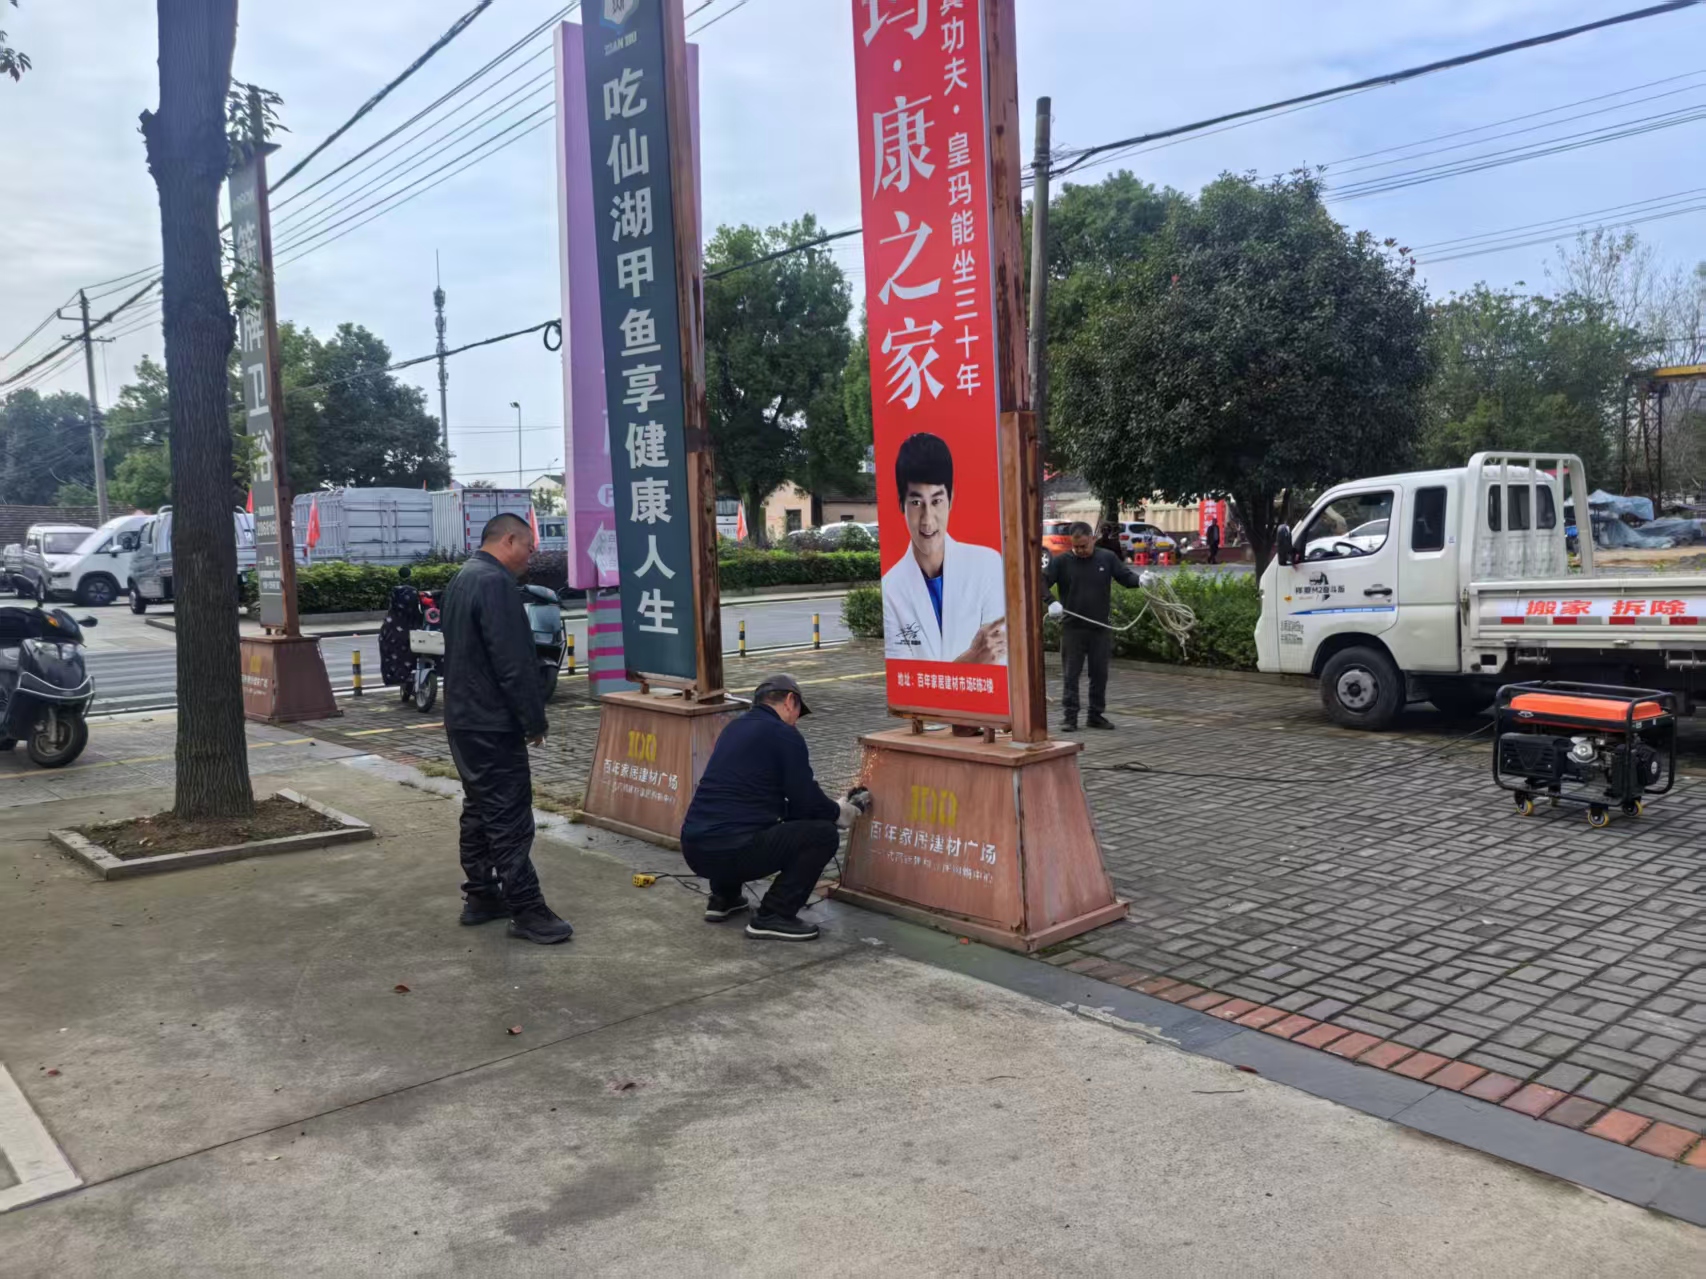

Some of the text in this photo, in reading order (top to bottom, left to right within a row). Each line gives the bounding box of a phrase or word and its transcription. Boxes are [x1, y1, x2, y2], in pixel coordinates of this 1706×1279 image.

[603, 67, 679, 636] 吃仙湖甲鱼享健康人生
[1526, 600, 1688, 615] 搬家 拆除
[603, 758, 678, 791] 百年家居建材广场
[870, 820, 996, 865] 百年家居建材广场
